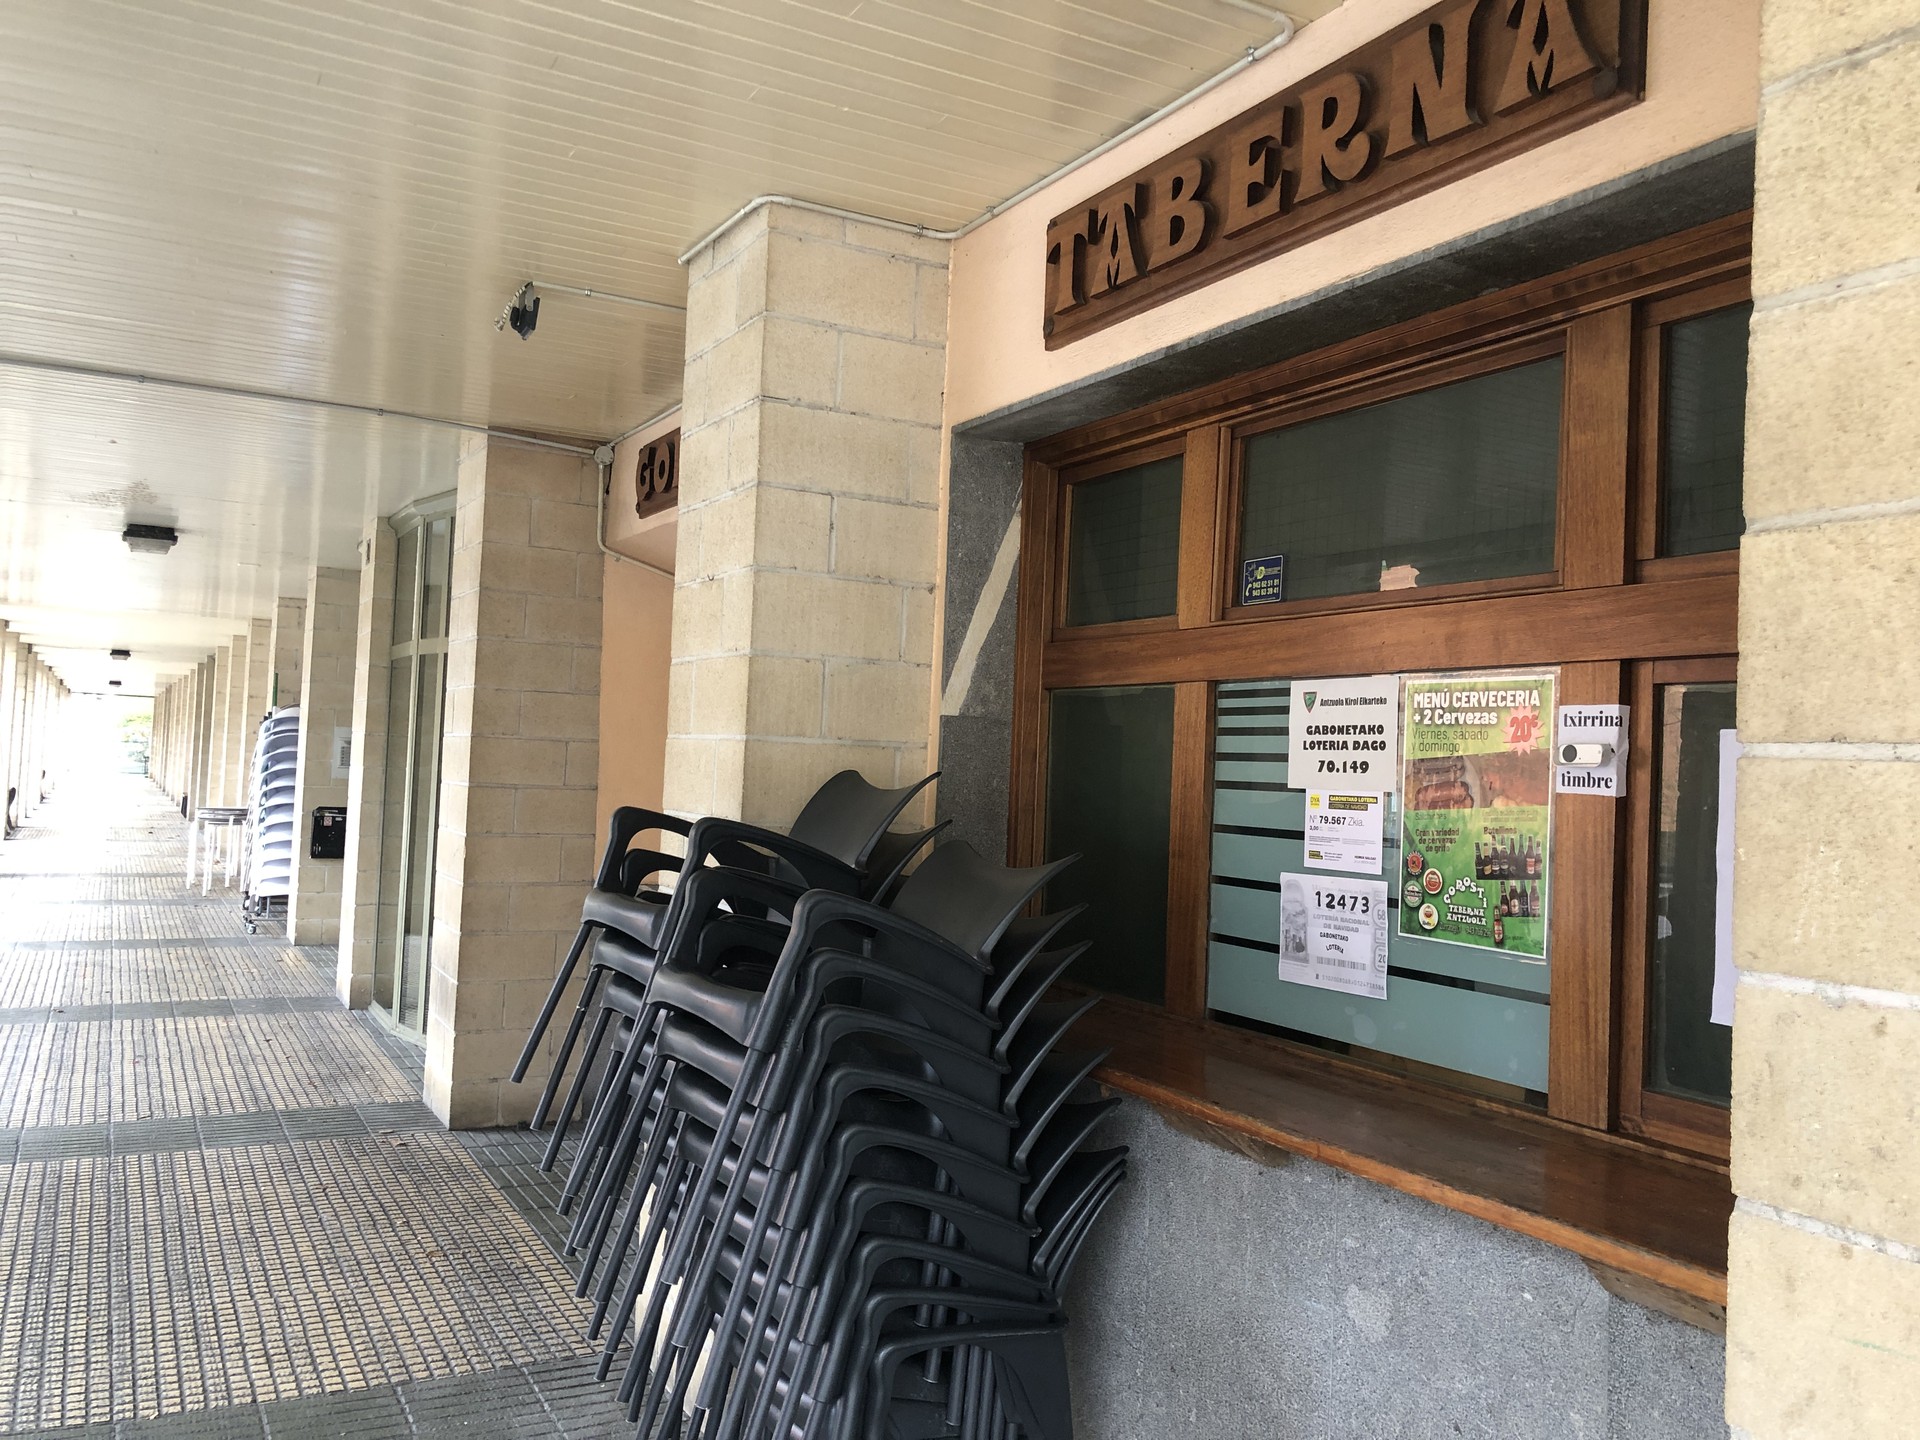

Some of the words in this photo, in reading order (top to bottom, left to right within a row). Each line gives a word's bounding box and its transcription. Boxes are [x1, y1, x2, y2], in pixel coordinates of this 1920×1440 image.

[1047, 0, 1599, 306] TABERNA
[1320, 698, 1344, 707] Antzuola
[1345, 697, 1359, 706] Kirol
[1359, 696, 1387, 706] Elkarteko
[1413, 688, 1450, 709] MENÚ
[1452, 689, 1541, 708] CERVECERIA
[1423, 709, 1432, 725] 2
[1434, 709, 1498, 725] Cervezas
[1563, 710, 1623, 728] txirrina
[1306, 724, 1385, 736] GABONETAKO
[1413, 728, 1450, 741] Viernes,
[1453, 727, 1489, 741] sábado
[1303, 740, 1349, 751] LOTERIA
[1352, 740, 1387, 751] DAGO
[1411, 743, 1416, 754] y
[1419, 741, 1460, 755] domingo
[1317, 760, 1370, 774] 70.149
[1561, 770, 1613, 789] timbre
[1319, 815, 1347, 825] 79.567
[1415, 828, 1431, 837] Gran
[1431, 827, 1460, 837] variedad
[1315, 890, 1370, 914] 12473
[1448, 904, 1485, 916] TABERNA
[1446, 913, 1487, 926] ANTZUOLA
[1323, 922, 1332, 930] DE
[1333, 924, 1360, 933] NAVIDAD
[1319, 931, 1349, 942] GABONETAKO
[1326, 944, 1344, 954] LOTERIA
